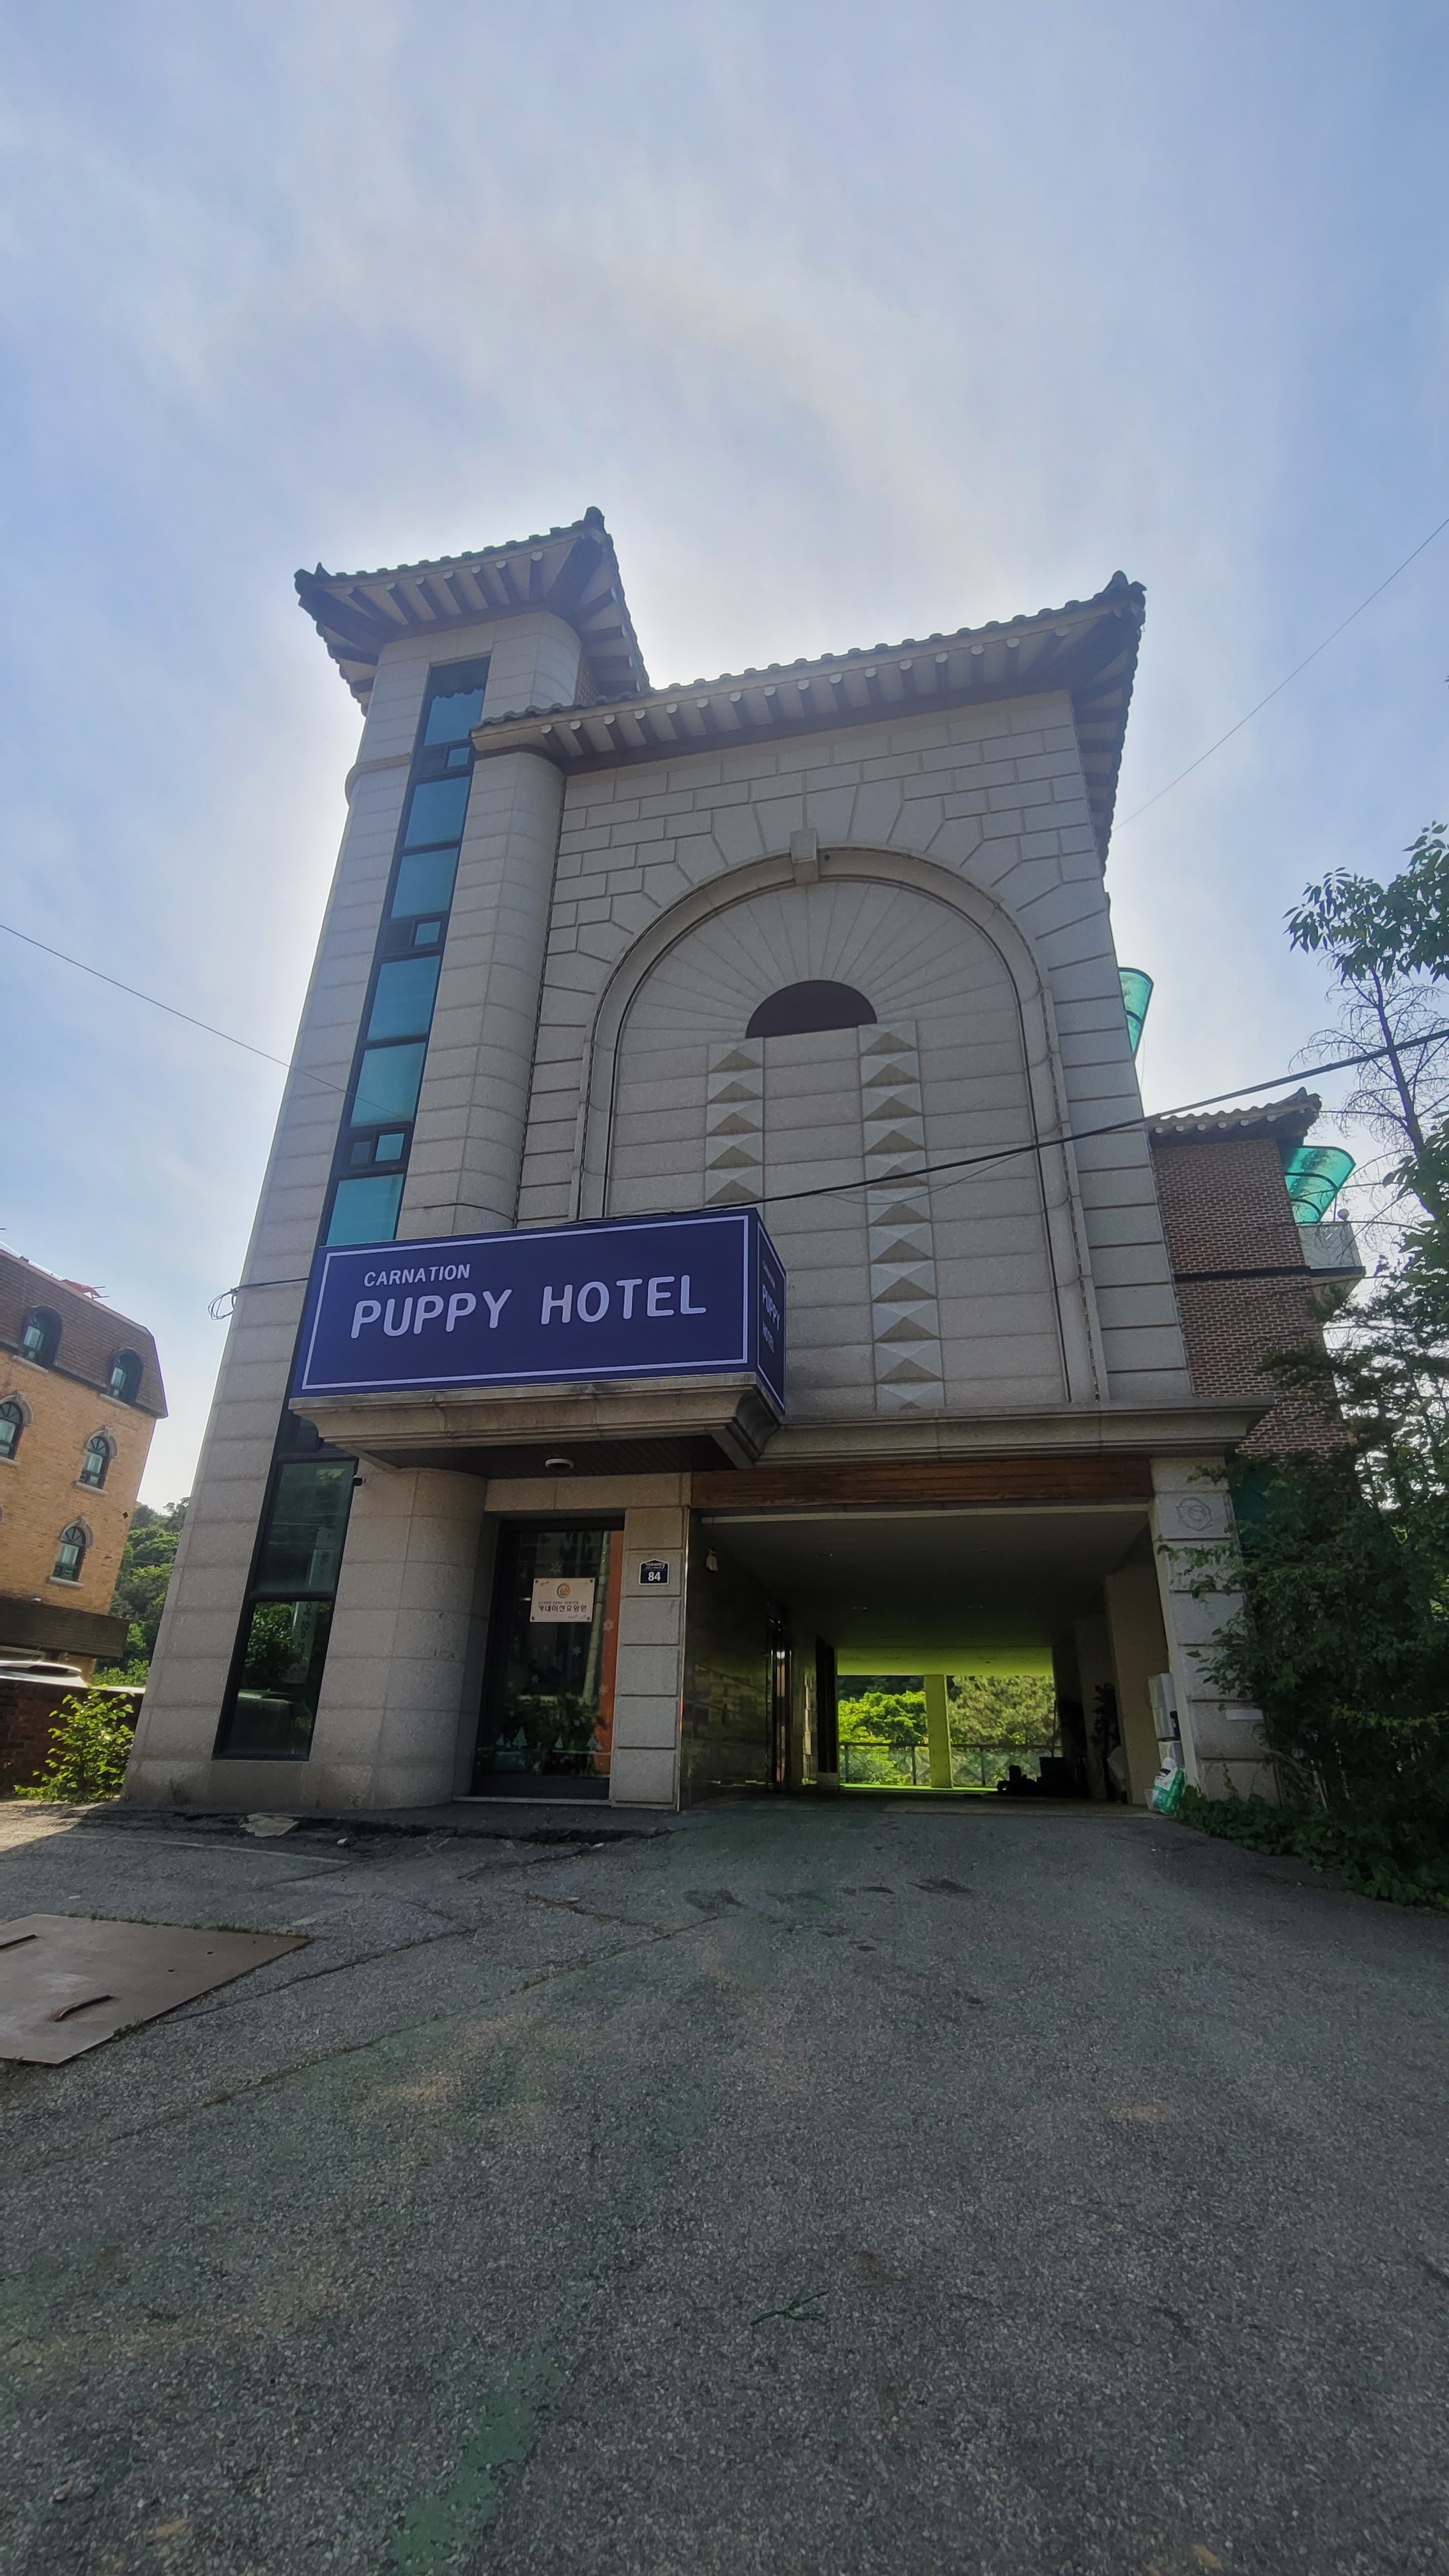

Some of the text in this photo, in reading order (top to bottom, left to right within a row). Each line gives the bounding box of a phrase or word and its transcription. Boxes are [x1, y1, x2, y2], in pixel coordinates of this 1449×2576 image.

[364, 1264, 470, 1287] CARNATION
[351, 1289, 512, 1338] PUPPY
[541, 1275, 707, 1324] HOTEL
[762, 1284, 780, 1331] PUPPY
[648, 1572, 661, 1581] 84
